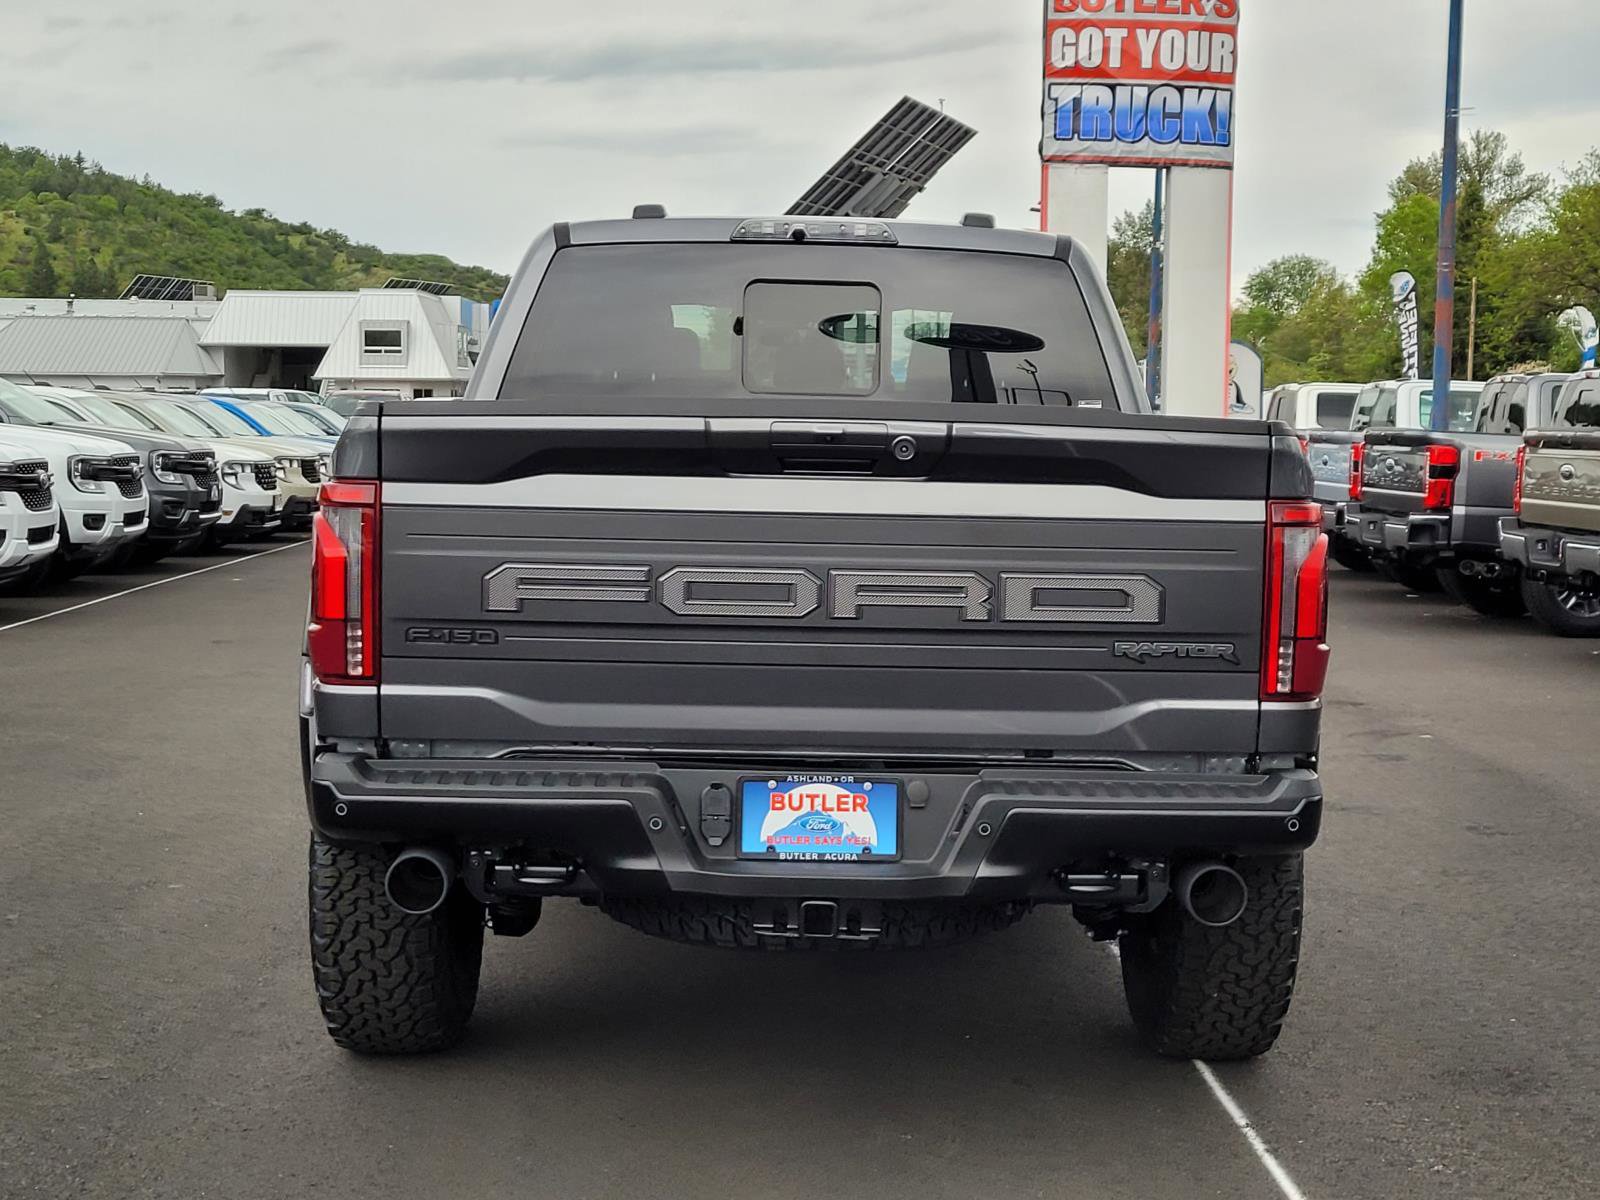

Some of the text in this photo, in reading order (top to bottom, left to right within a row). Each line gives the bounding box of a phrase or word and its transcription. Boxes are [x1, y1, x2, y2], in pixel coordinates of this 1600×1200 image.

[1050, 27, 1234, 73] GOT YOUR
[1048, 83, 1233, 146] TRUCK!
[481, 562, 1166, 624] FORD
[406, 627, 498, 644] F-150
[1113, 641, 1240, 666] RAPTOR
[786, 775, 833, 783] ASHLAND
[770, 792, 868, 812] BUTLER
[806, 817, 833, 830] Ford
[766, 836, 871, 845] BUTLER SAYS YES!
[779, 852, 858, 861] BUTLER ACURA
